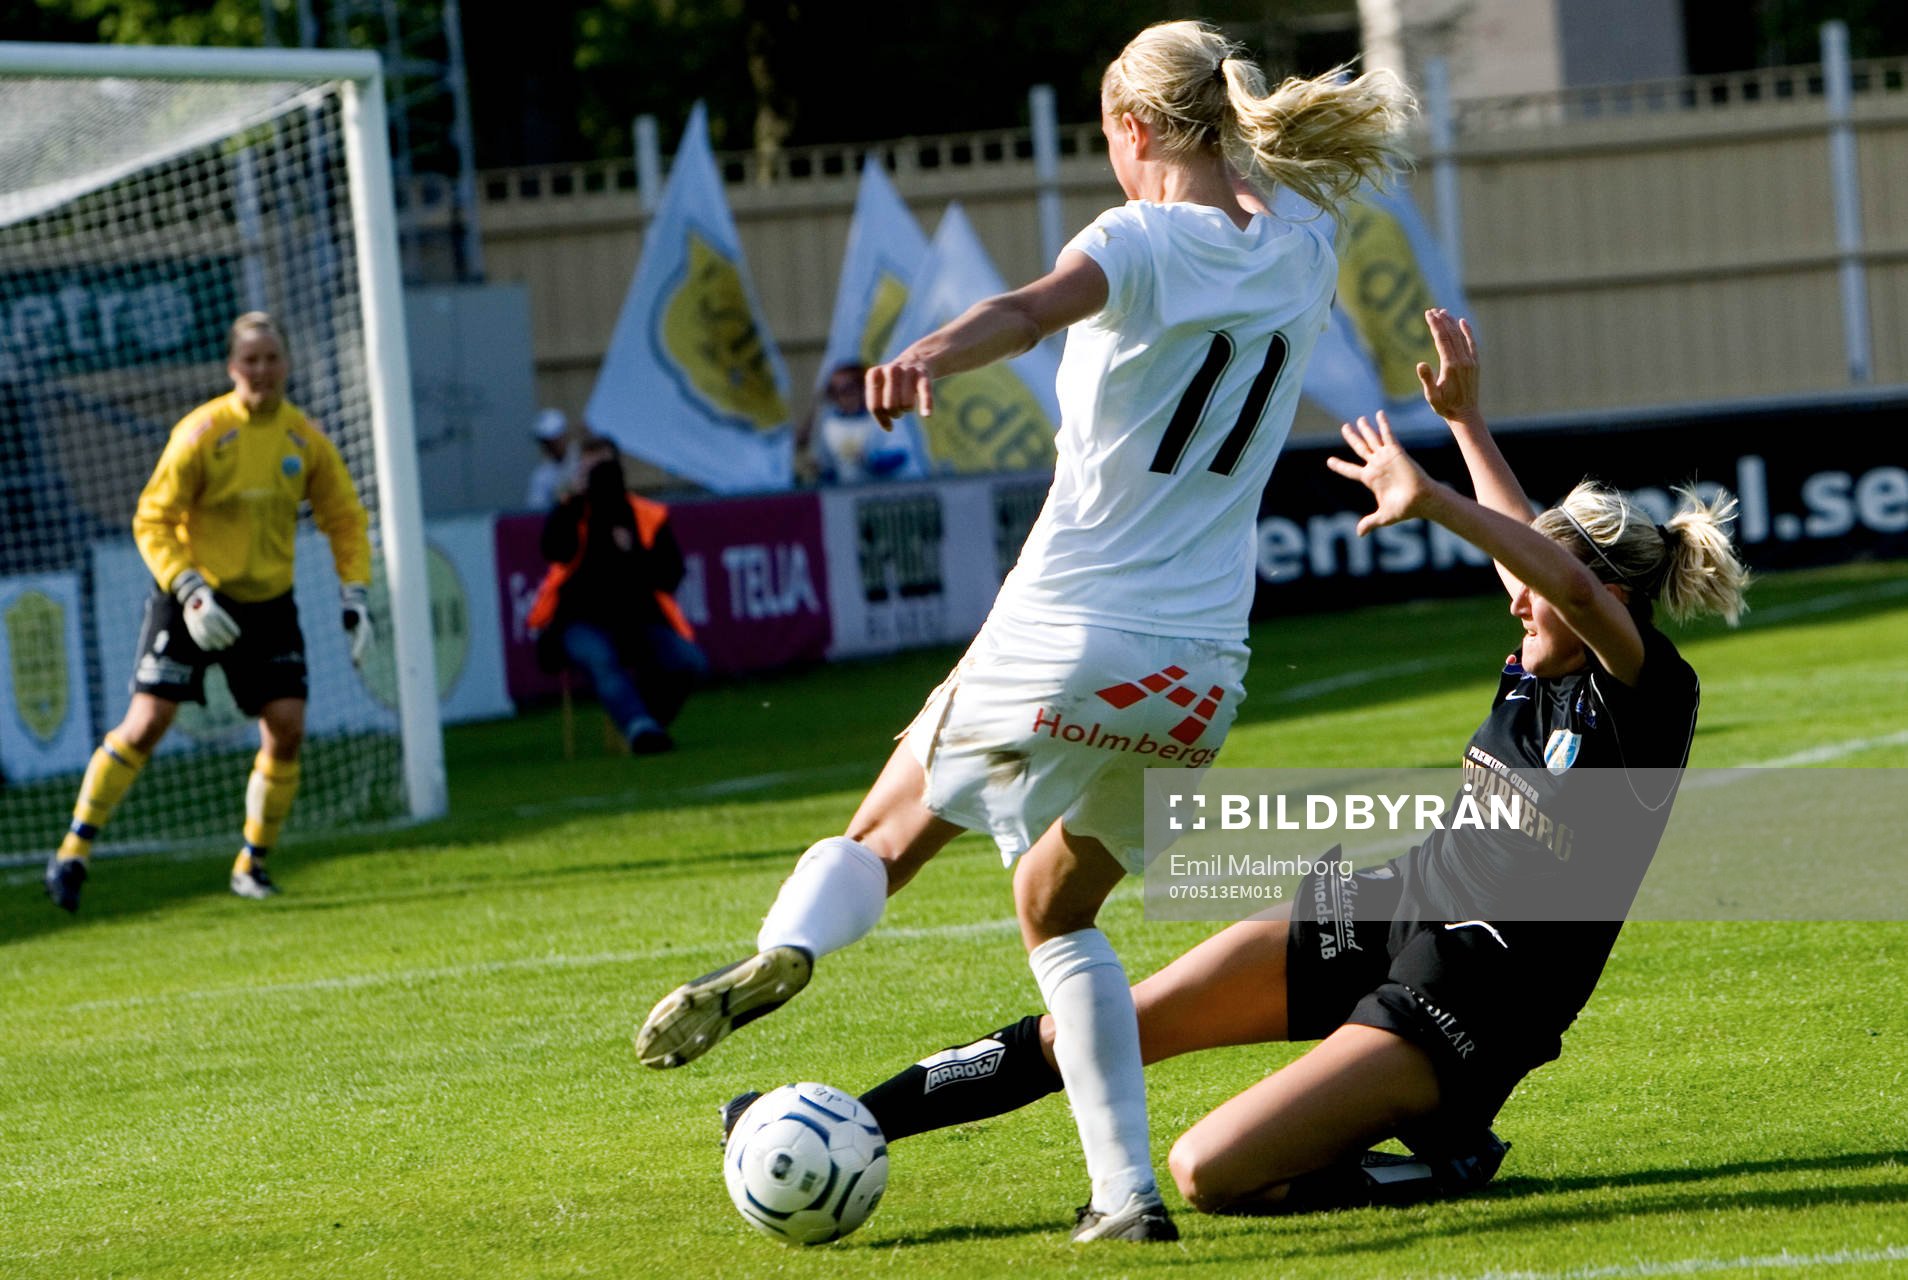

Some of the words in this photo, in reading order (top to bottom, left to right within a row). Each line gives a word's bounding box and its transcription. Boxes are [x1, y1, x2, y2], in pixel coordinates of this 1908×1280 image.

[1148, 329, 1290, 477] 11
[1032, 707, 1219, 769] Holmbergs
[1469, 746, 1511, 778] PREMIUM
[1510, 772, 1540, 803] CIDER
[1340, 877, 1363, 951] Ekstrand
[1319, 931, 1337, 960] AB
[930, 1055, 997, 1088] ARROW
